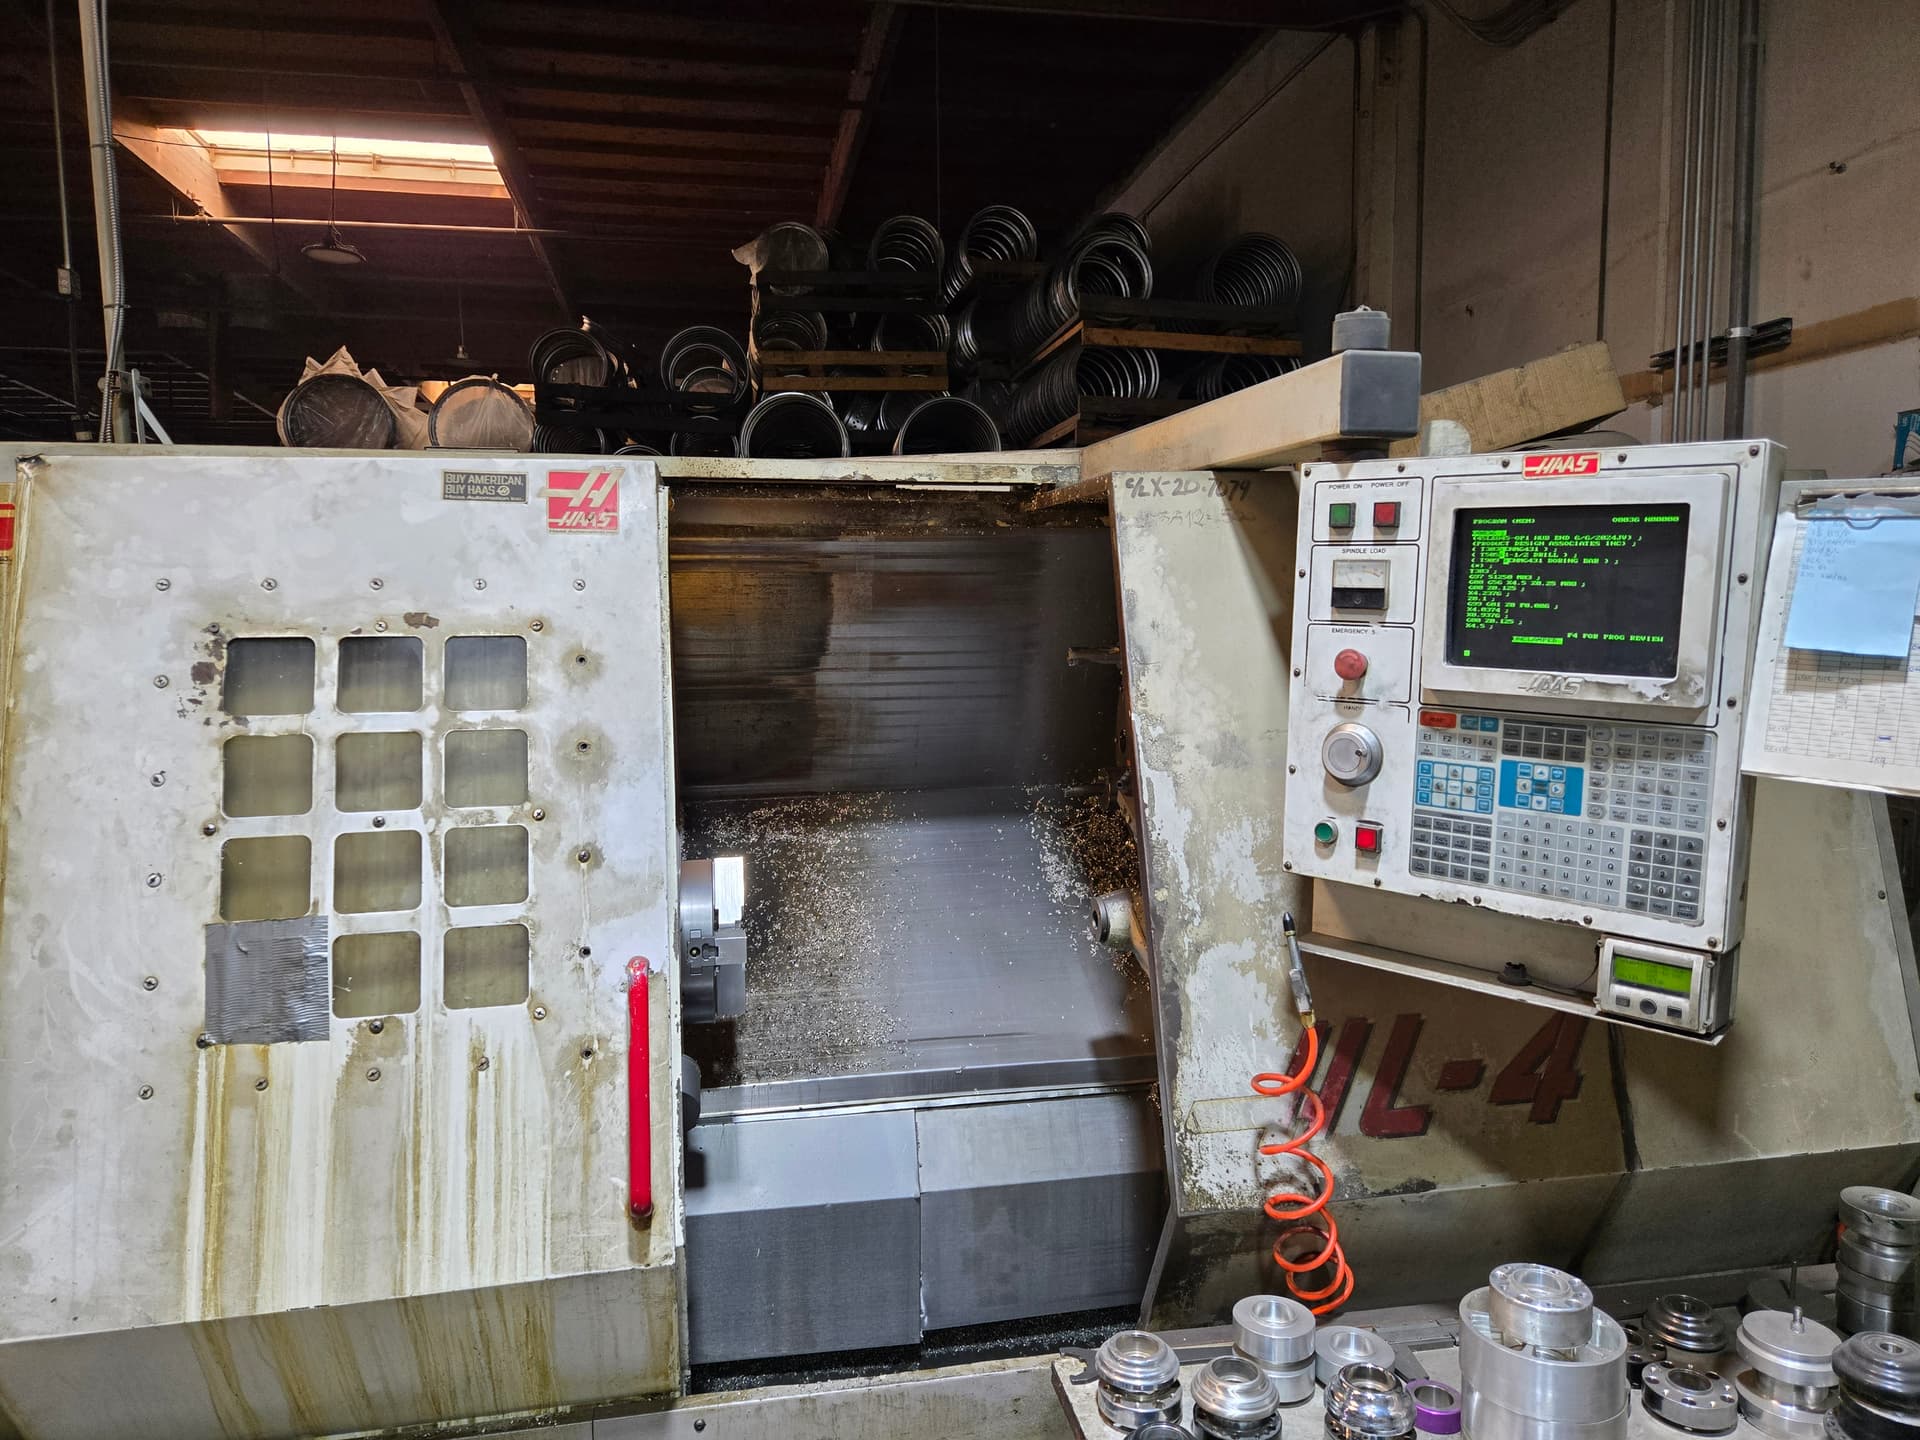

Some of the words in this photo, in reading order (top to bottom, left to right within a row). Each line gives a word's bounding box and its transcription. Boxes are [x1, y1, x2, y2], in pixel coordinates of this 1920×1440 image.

[1525, 454, 1600, 474] HAAS
[446, 474, 466, 484] BUY
[468, 474, 524, 486] AMERICAN,
[446, 484, 466, 494] BUY
[468, 485, 496, 496] HAAS
[548, 511, 618, 528] HAAS
[1518, 674, 1582, 694] HAAS
